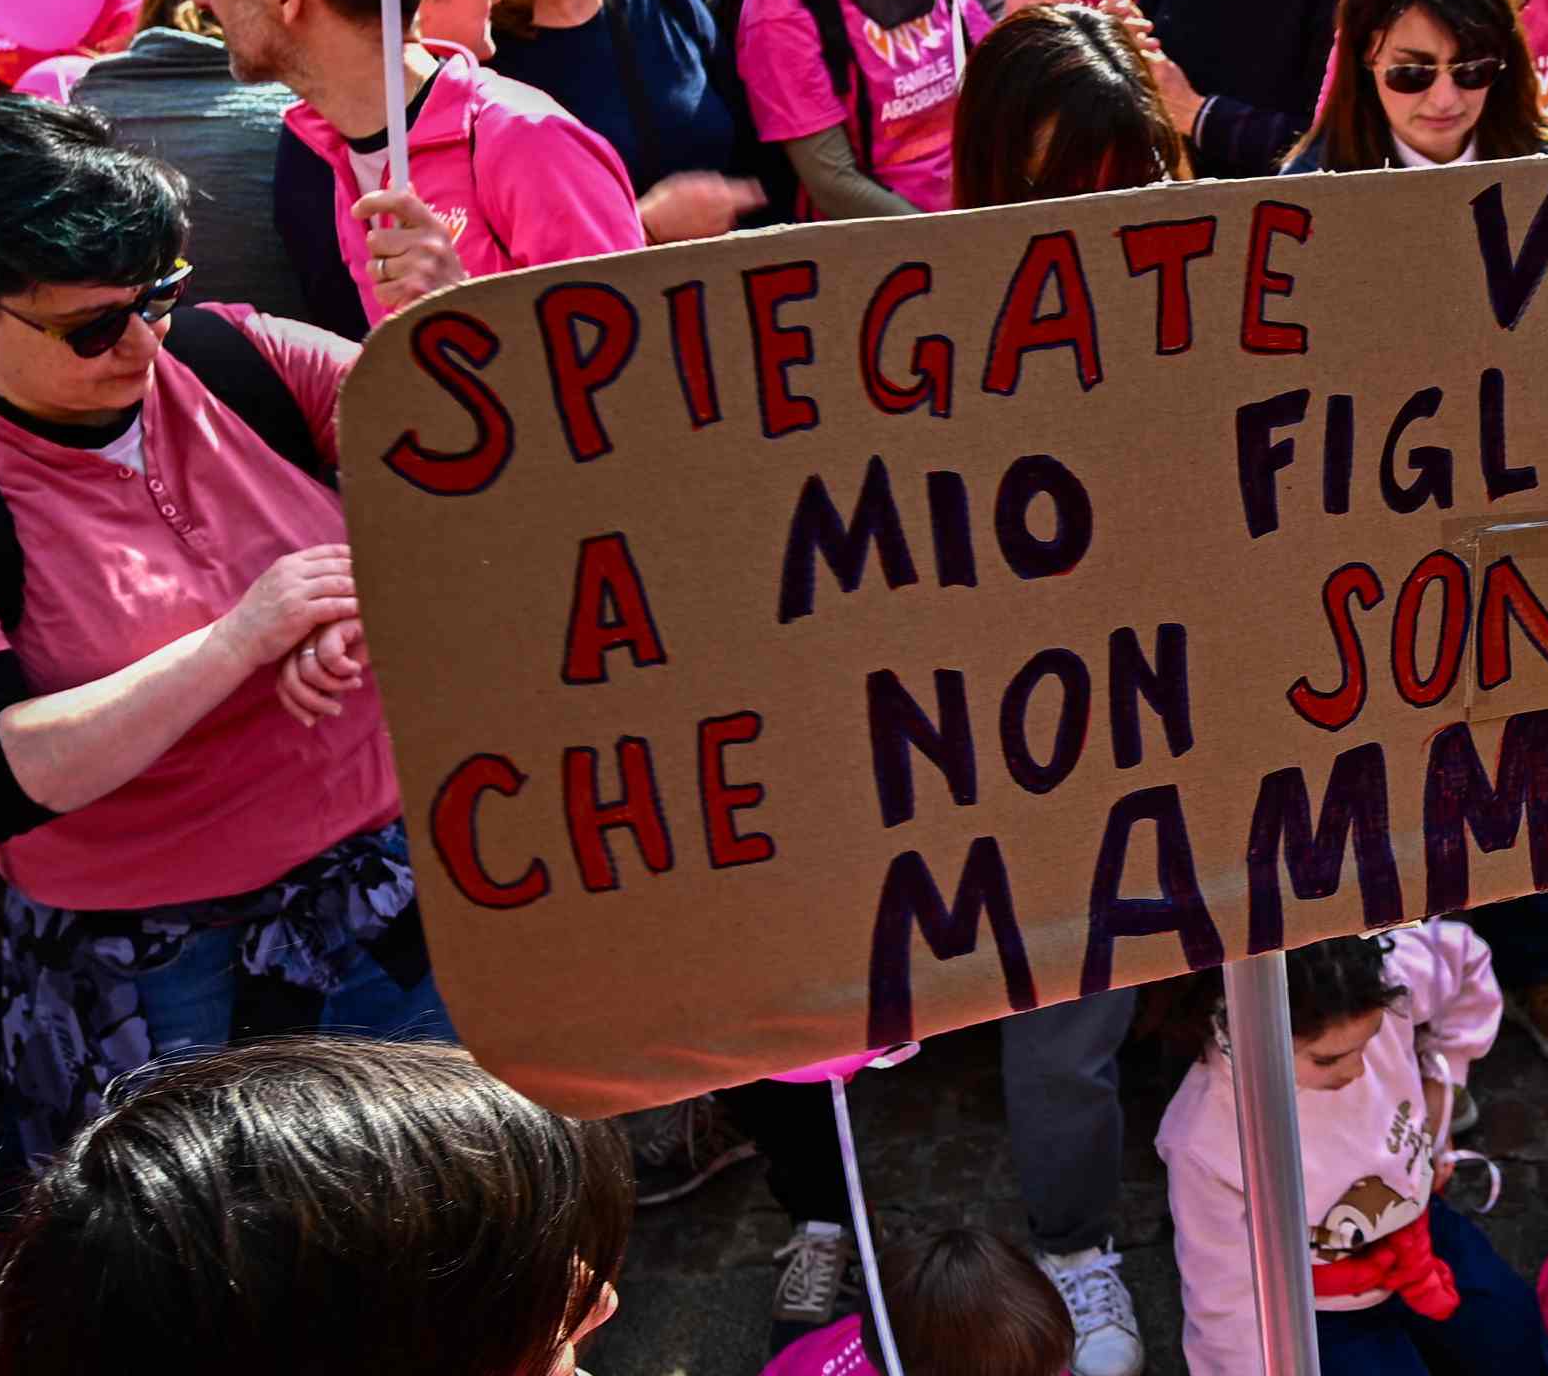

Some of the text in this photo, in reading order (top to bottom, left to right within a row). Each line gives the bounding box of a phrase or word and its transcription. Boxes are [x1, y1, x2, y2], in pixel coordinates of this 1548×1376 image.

[382, 200, 1314, 496] SPIEGATE
[562, 532, 666, 686] A
[776, 453, 1095, 623] MIO
[430, 710, 776, 910] CHE
[866, 623, 1196, 829] NON
